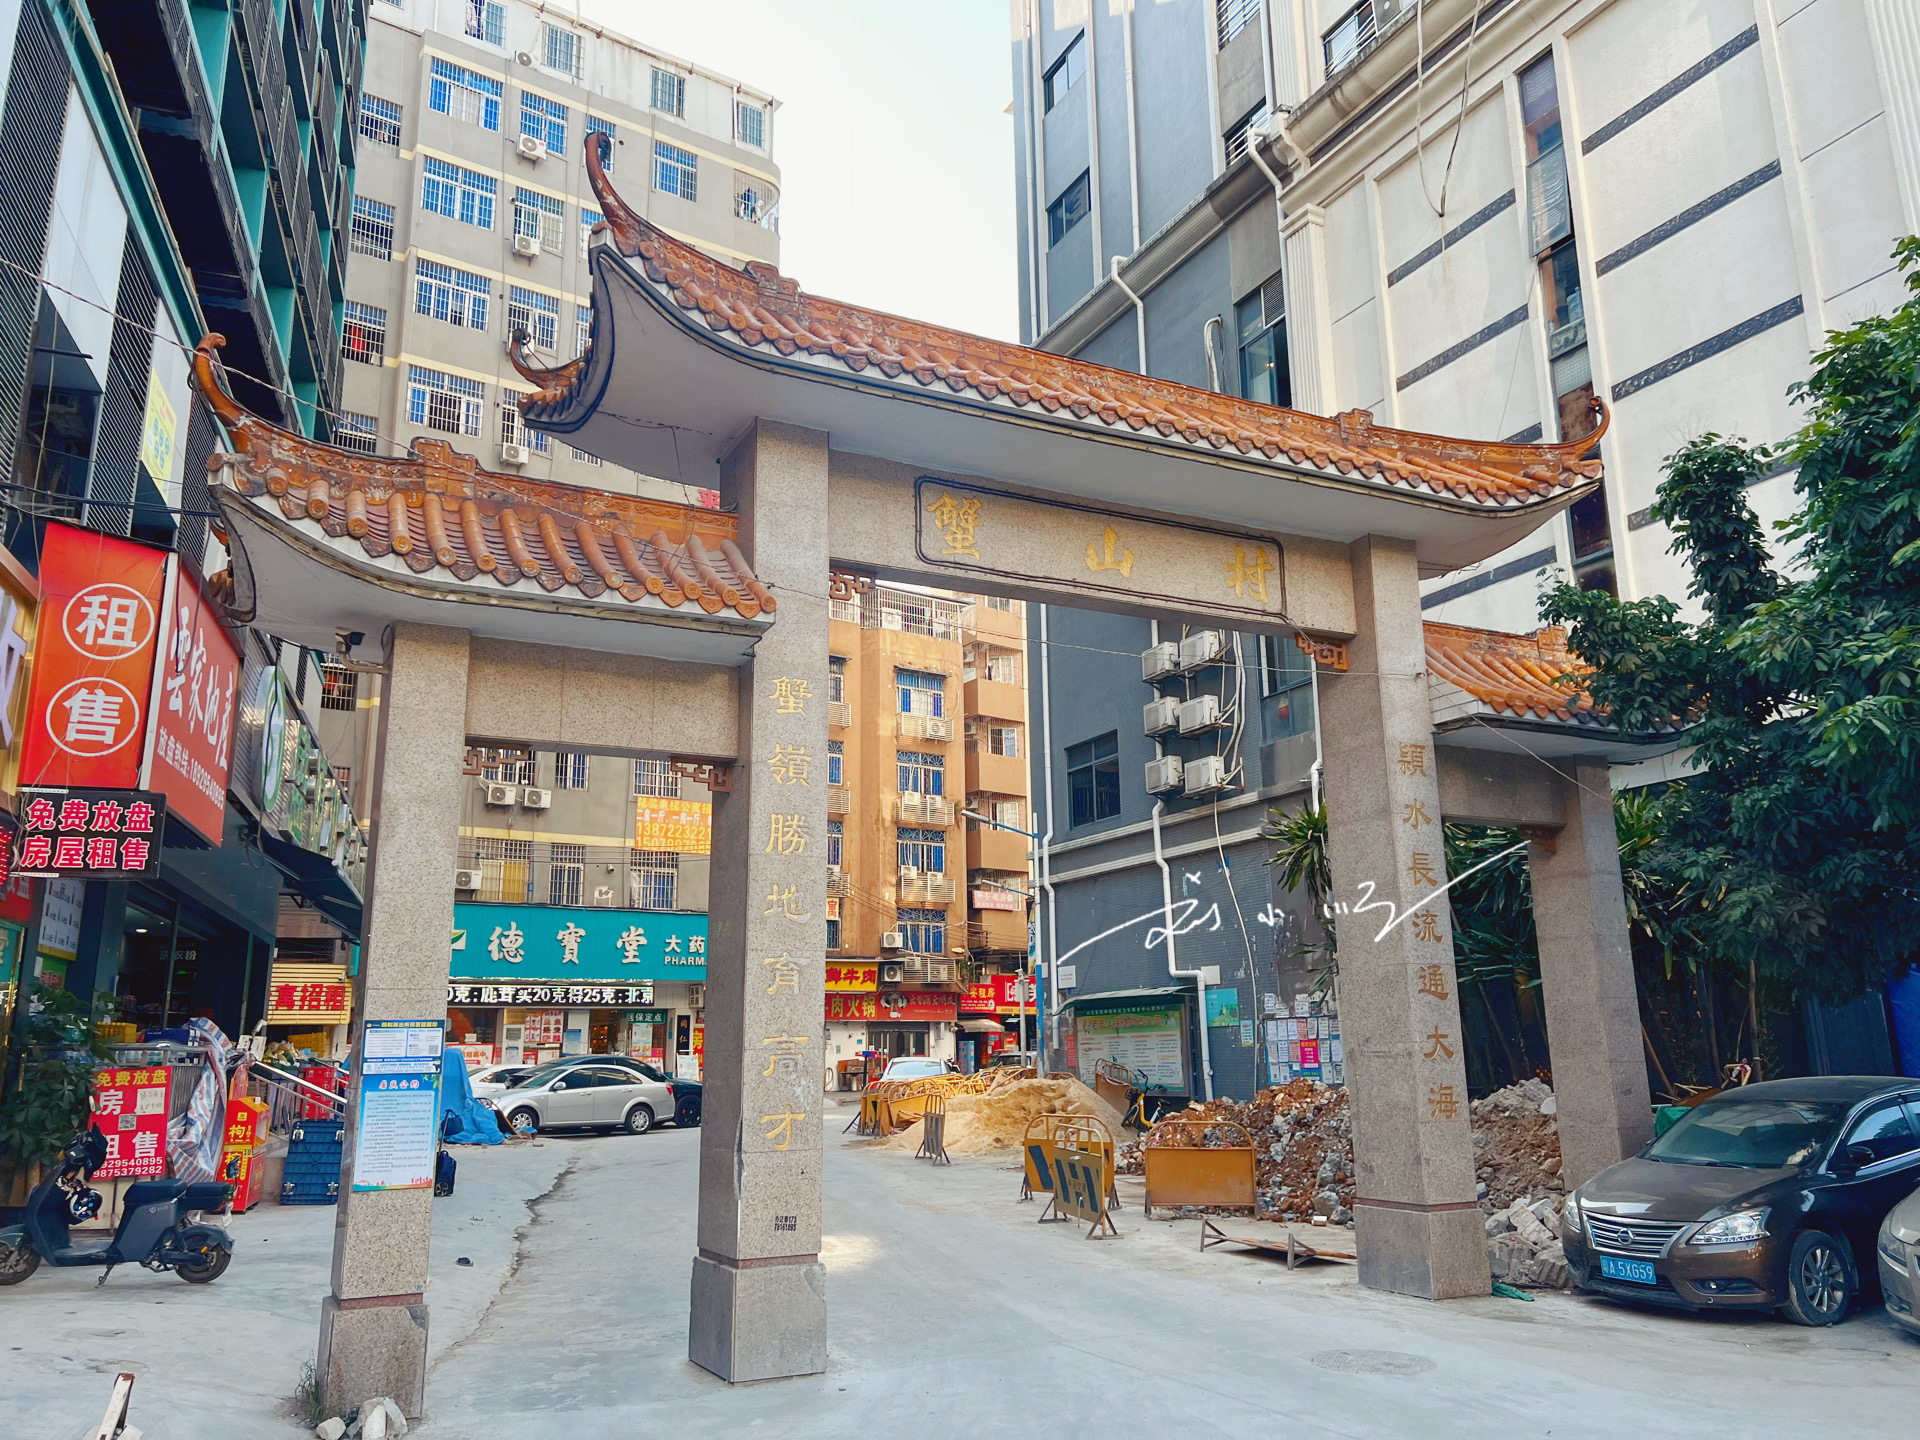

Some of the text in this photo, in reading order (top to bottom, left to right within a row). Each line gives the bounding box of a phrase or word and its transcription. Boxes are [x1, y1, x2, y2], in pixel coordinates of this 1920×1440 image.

[926, 490, 1274, 604] 蟹山村
[26, 797, 154, 834] 免费放盘
[20, 835, 150, 871] 房屋租售
[488, 921, 647, 964] 德寶堂
[664, 934, 706, 954] 大药
[664, 956, 707, 966] PHARM
[270, 983, 346, 1010] 寓招租
[825, 994, 876, 1018] 肉火锅
[963, 986, 996, 999] 安租房
[97, 1069, 168, 1087] 免费放盘
[96, 1088, 124, 1115] 房
